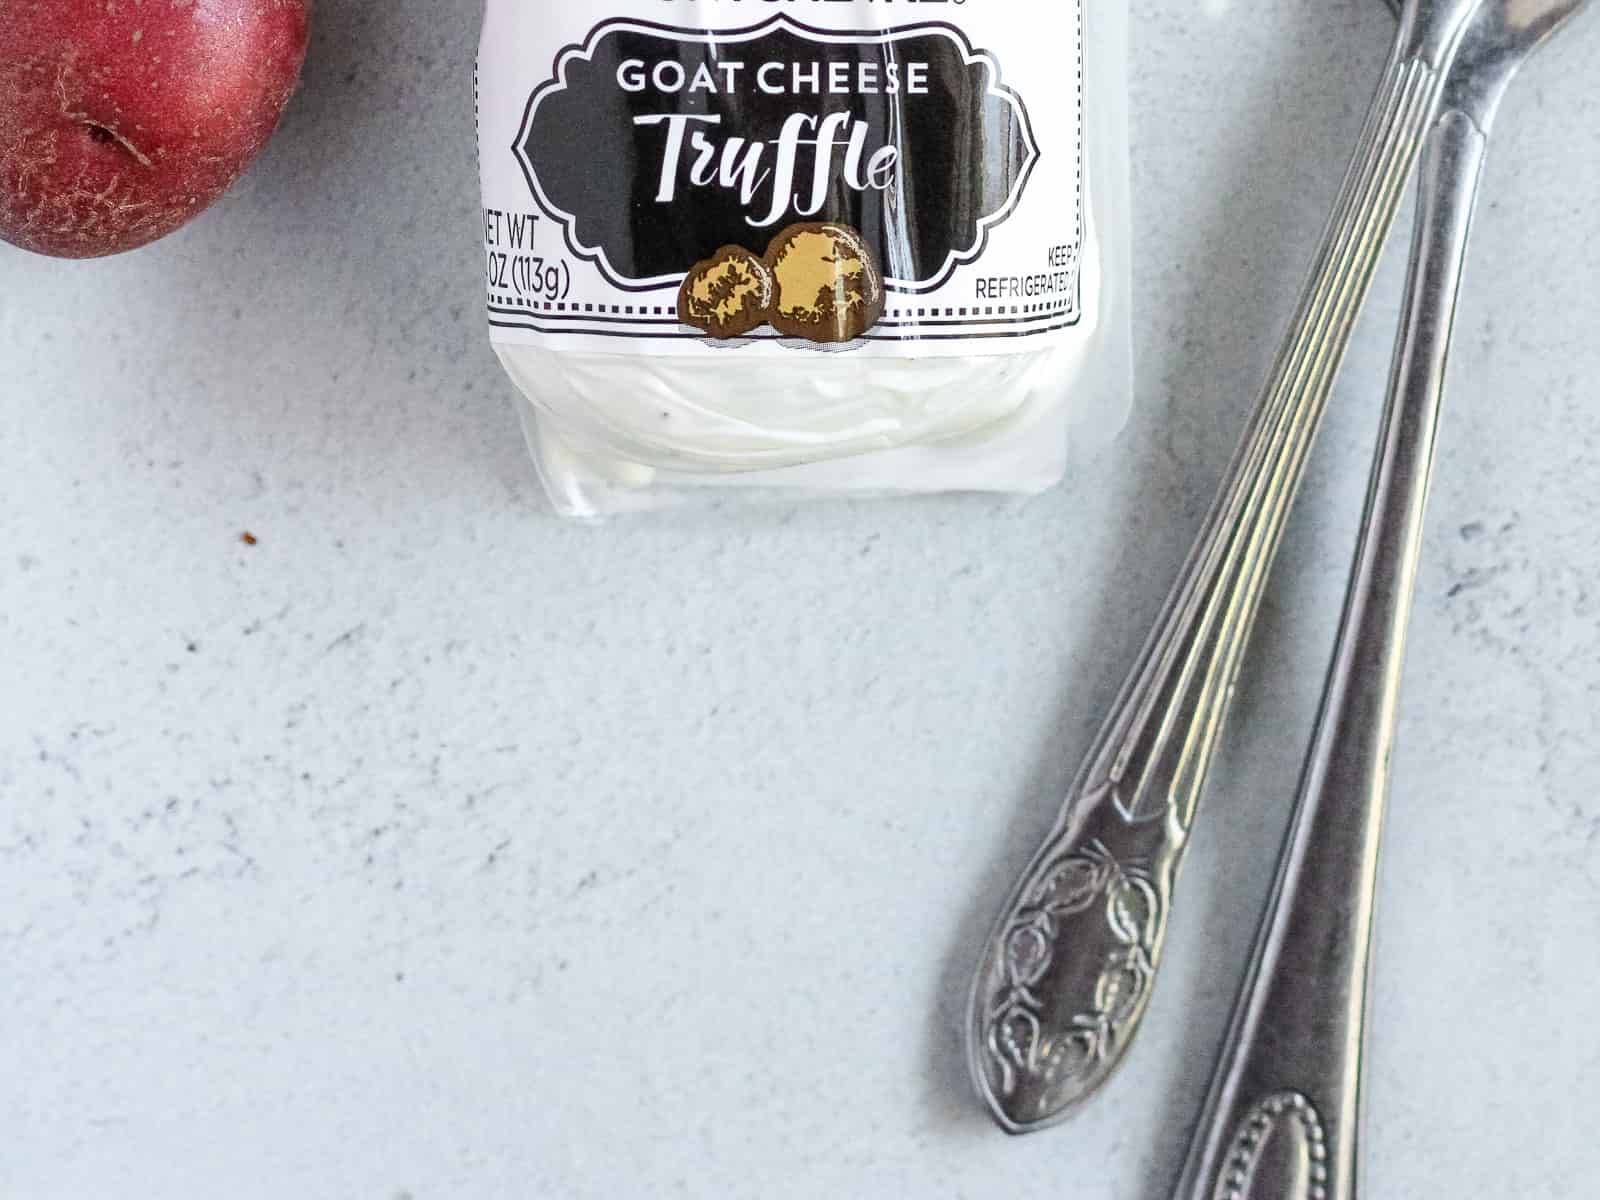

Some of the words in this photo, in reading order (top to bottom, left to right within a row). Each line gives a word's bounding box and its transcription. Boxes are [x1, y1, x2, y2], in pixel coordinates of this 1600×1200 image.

[616, 58, 744, 94] GOAT
[756, 61, 929, 95] CHEESE
[632, 110, 899, 228] Truffle
[506, 212, 540, 250] WT
[1048, 244, 1072, 268] KEEP
[489, 251, 509, 289] OZ
[512, 255, 570, 301] (113g)
